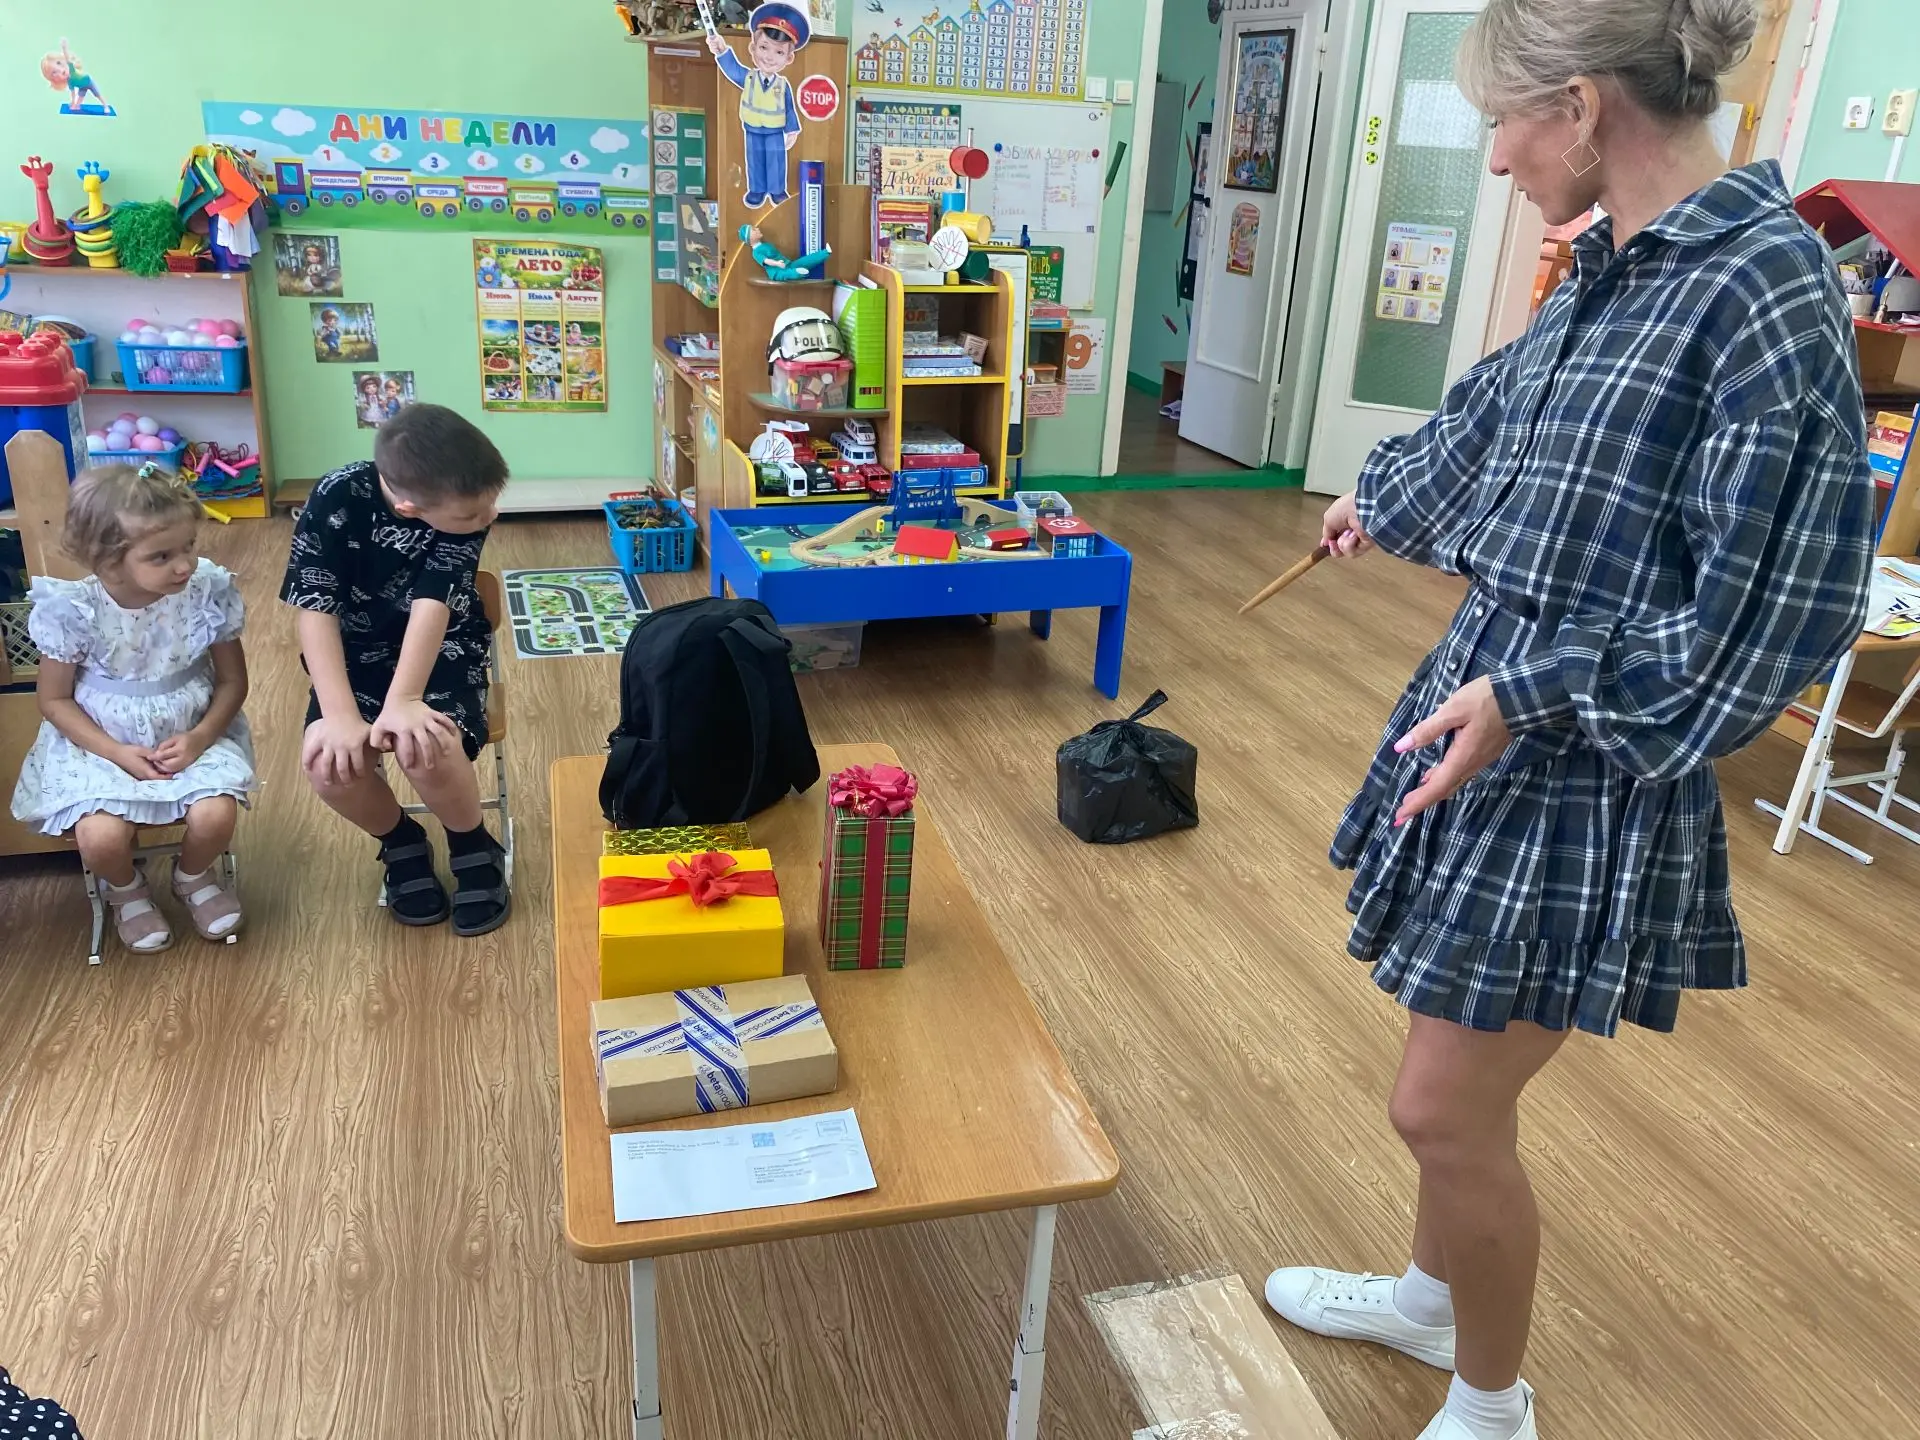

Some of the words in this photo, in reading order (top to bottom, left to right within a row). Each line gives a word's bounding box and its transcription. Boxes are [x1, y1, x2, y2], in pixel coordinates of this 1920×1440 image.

[804, 90, 833, 105] STOP
[884, 105, 934, 114] АЛФАВИТ
[330, 114, 408, 142] ДНИ
[420, 118, 556, 148] НЕДЕЛИ
[324, 150, 331, 161] 1
[382, 148, 390, 158] 2
[997, 146, 1040, 160] ЗБУКА
[431, 157, 438, 168] 3
[477, 155, 486, 166] 4
[524, 158, 532, 169] 5
[570, 154, 578, 164] 6
[621, 167, 628, 177] 7
[552, 249, 580, 257] ГОДА
[516, 260, 562, 271] ЛЕТО
[1065, 334, 1092, 369] 9
